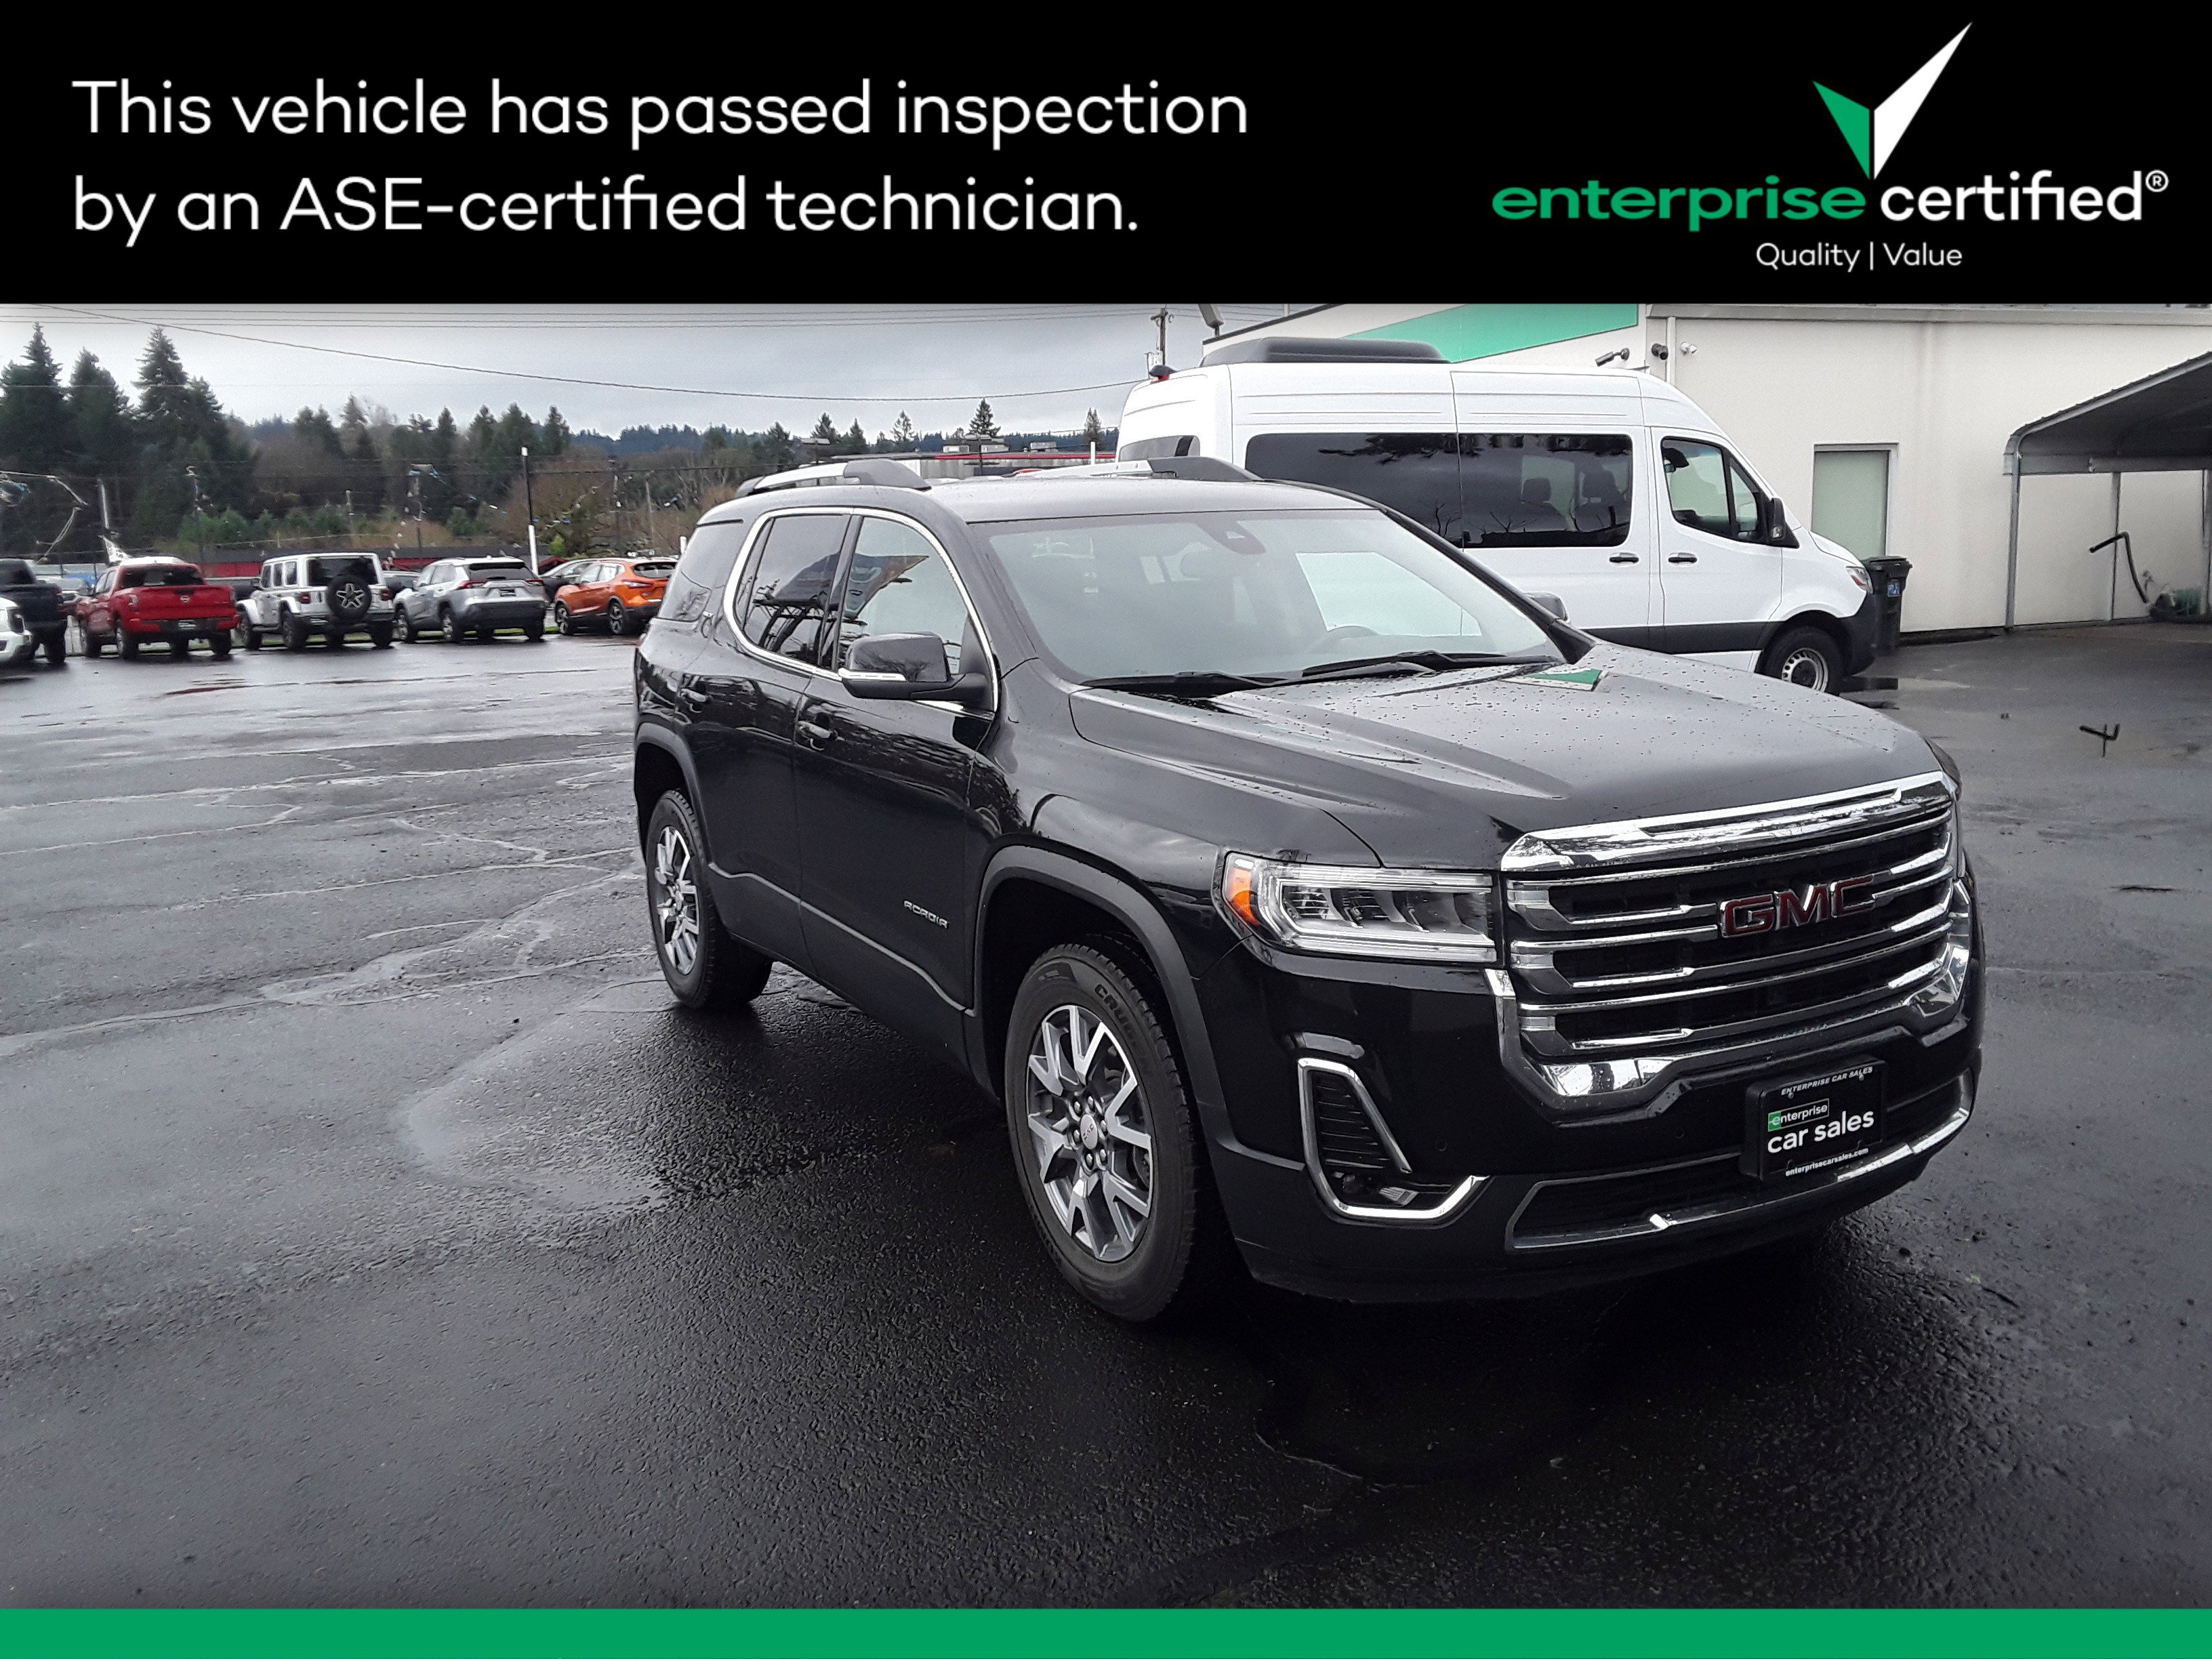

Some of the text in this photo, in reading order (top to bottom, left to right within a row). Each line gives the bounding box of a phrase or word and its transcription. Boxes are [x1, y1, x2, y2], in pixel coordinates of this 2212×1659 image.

[903, 899, 949, 929] ACADIA
[1720, 875, 1876, 938] GMC
[1781, 1066, 1873, 1096] ENTERPRISE CAR SALES
[1771, 1105, 1828, 1126] enterprise
[1767, 1111, 1875, 1153] car sales
[1785, 1147, 1869, 1177] enterprisecarsales.com
